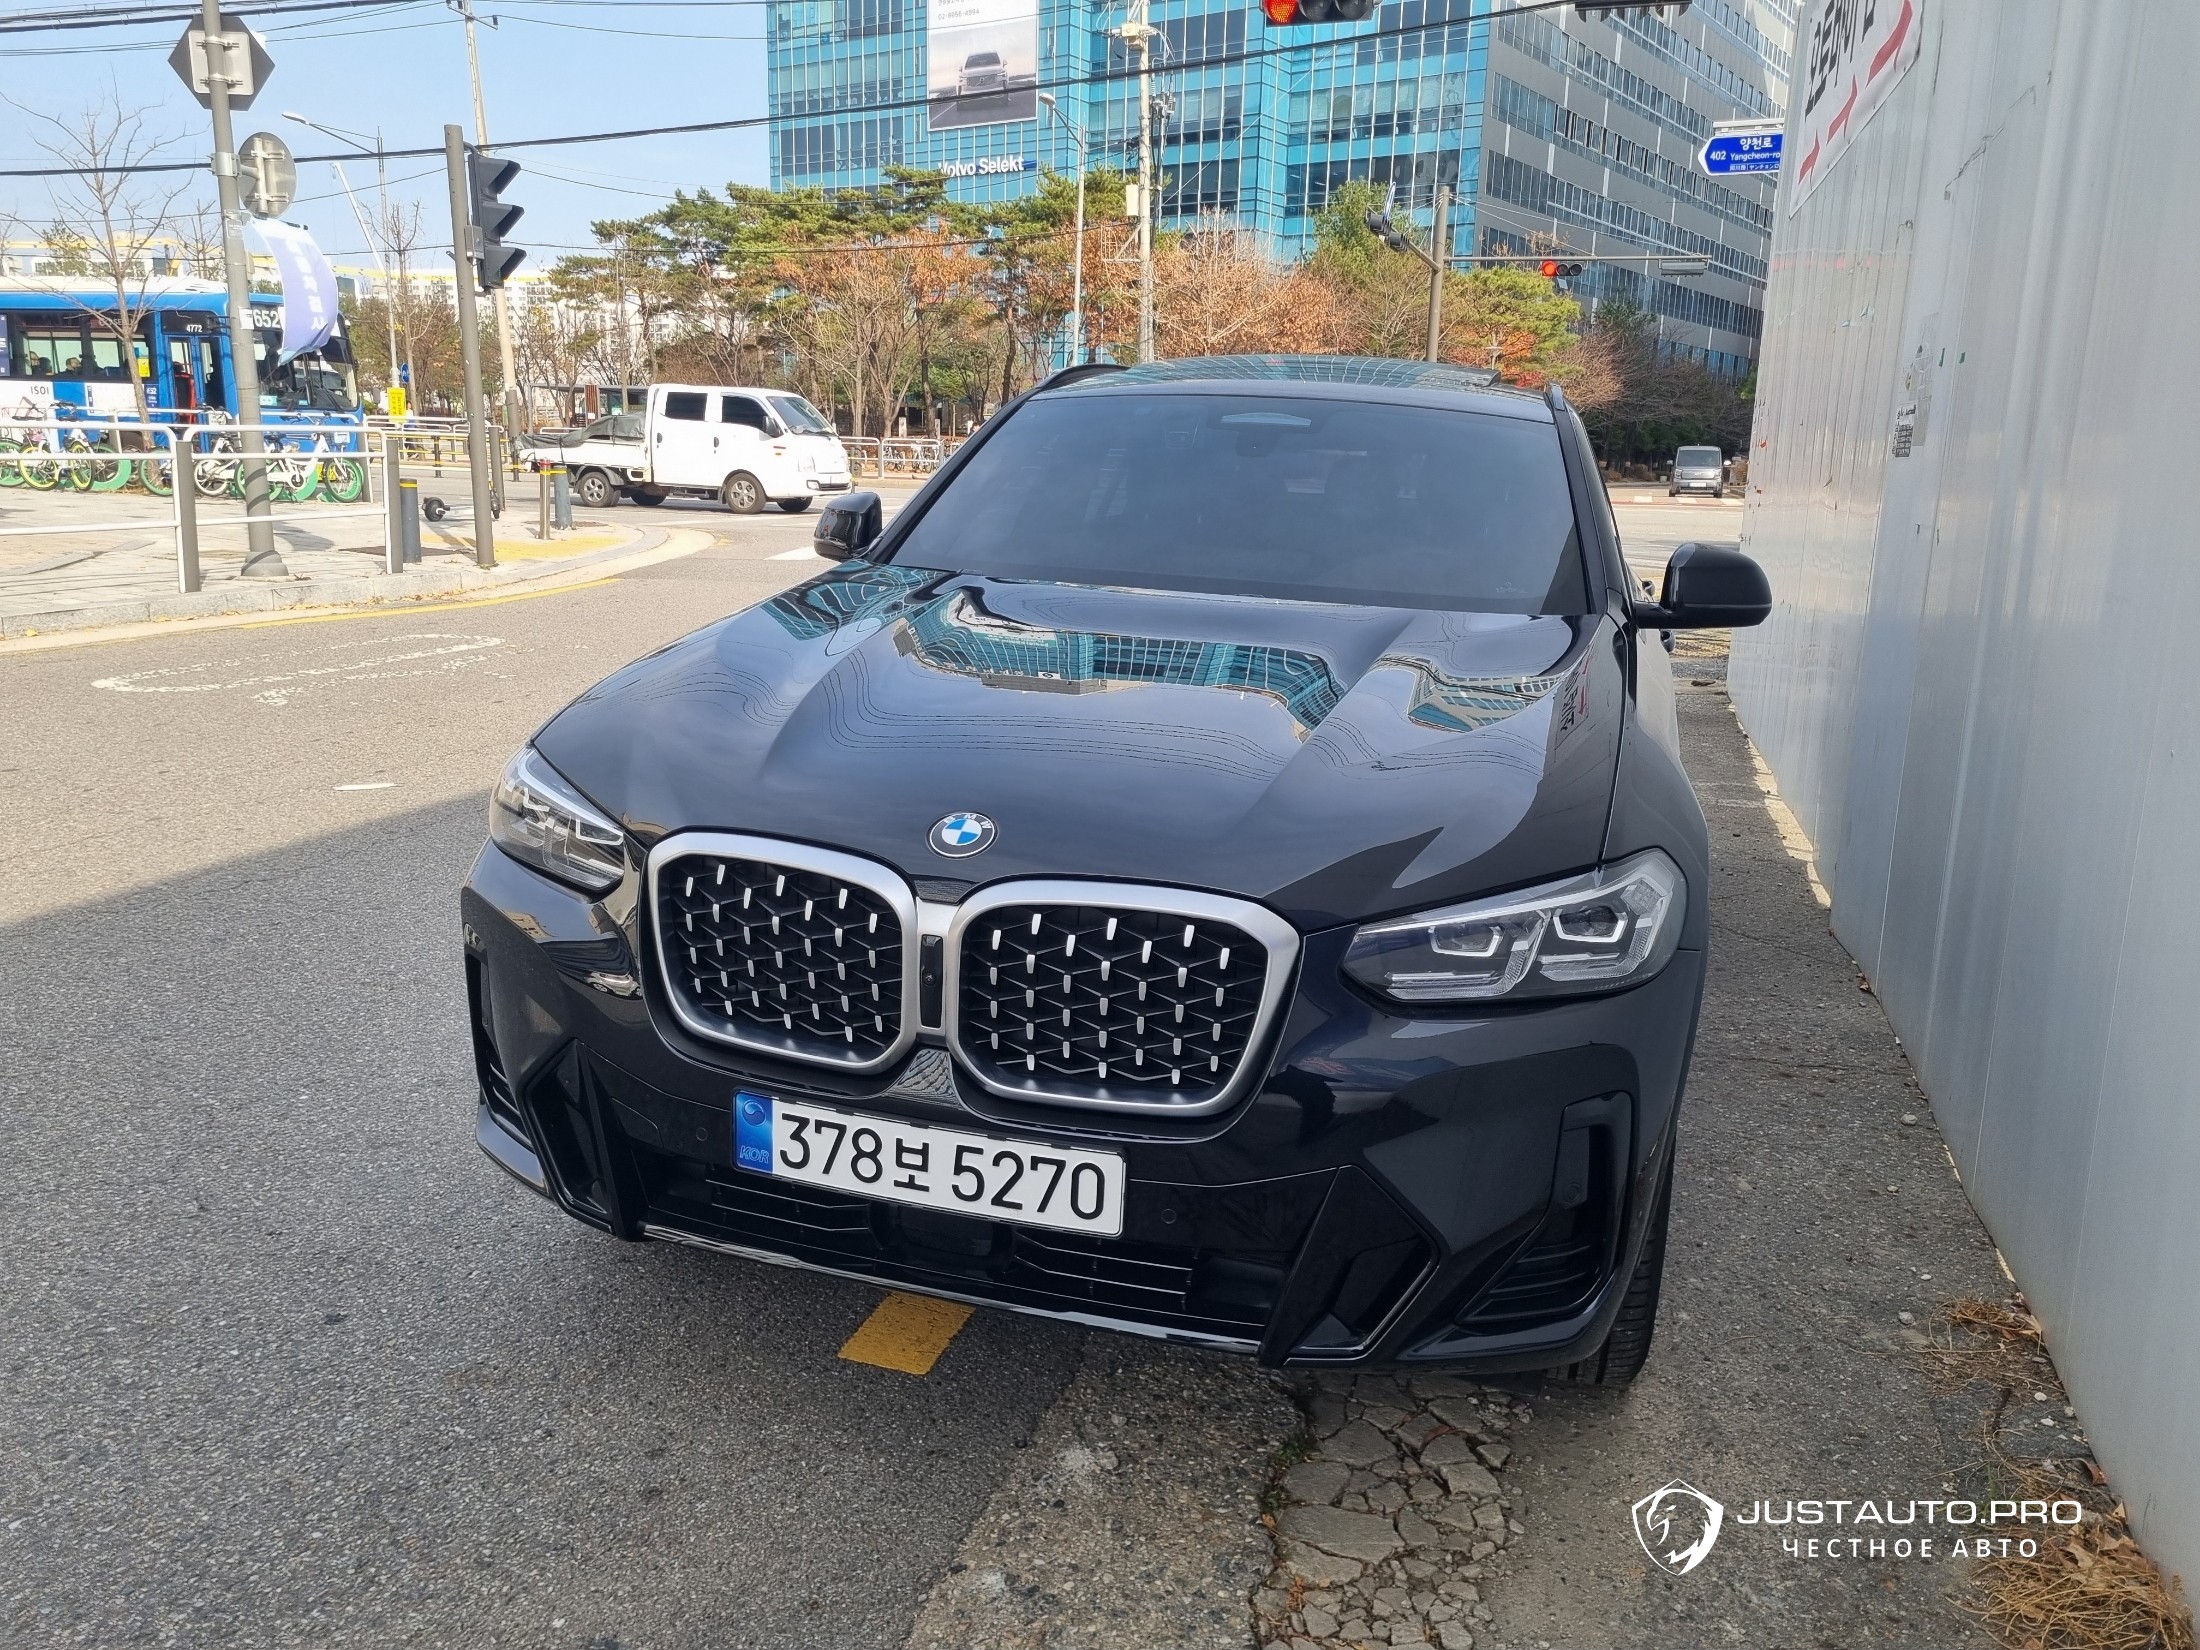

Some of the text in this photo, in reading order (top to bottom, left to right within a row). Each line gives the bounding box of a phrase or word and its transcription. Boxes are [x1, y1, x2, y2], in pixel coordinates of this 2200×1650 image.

[1740, 137, 1773, 151] 양천로
[1710, 151, 1727, 161] 402
[1730, 152, 1781, 162] Yangcheon-ro
[938, 154, 1025, 178] Volvo Selekt
[252, 309, 281, 328] 652
[186, 324, 203, 333] 4772
[943, 813, 992, 829] BMW
[740, 1145, 769, 1164] KOR
[951, 1144, 1105, 1220] 5270
